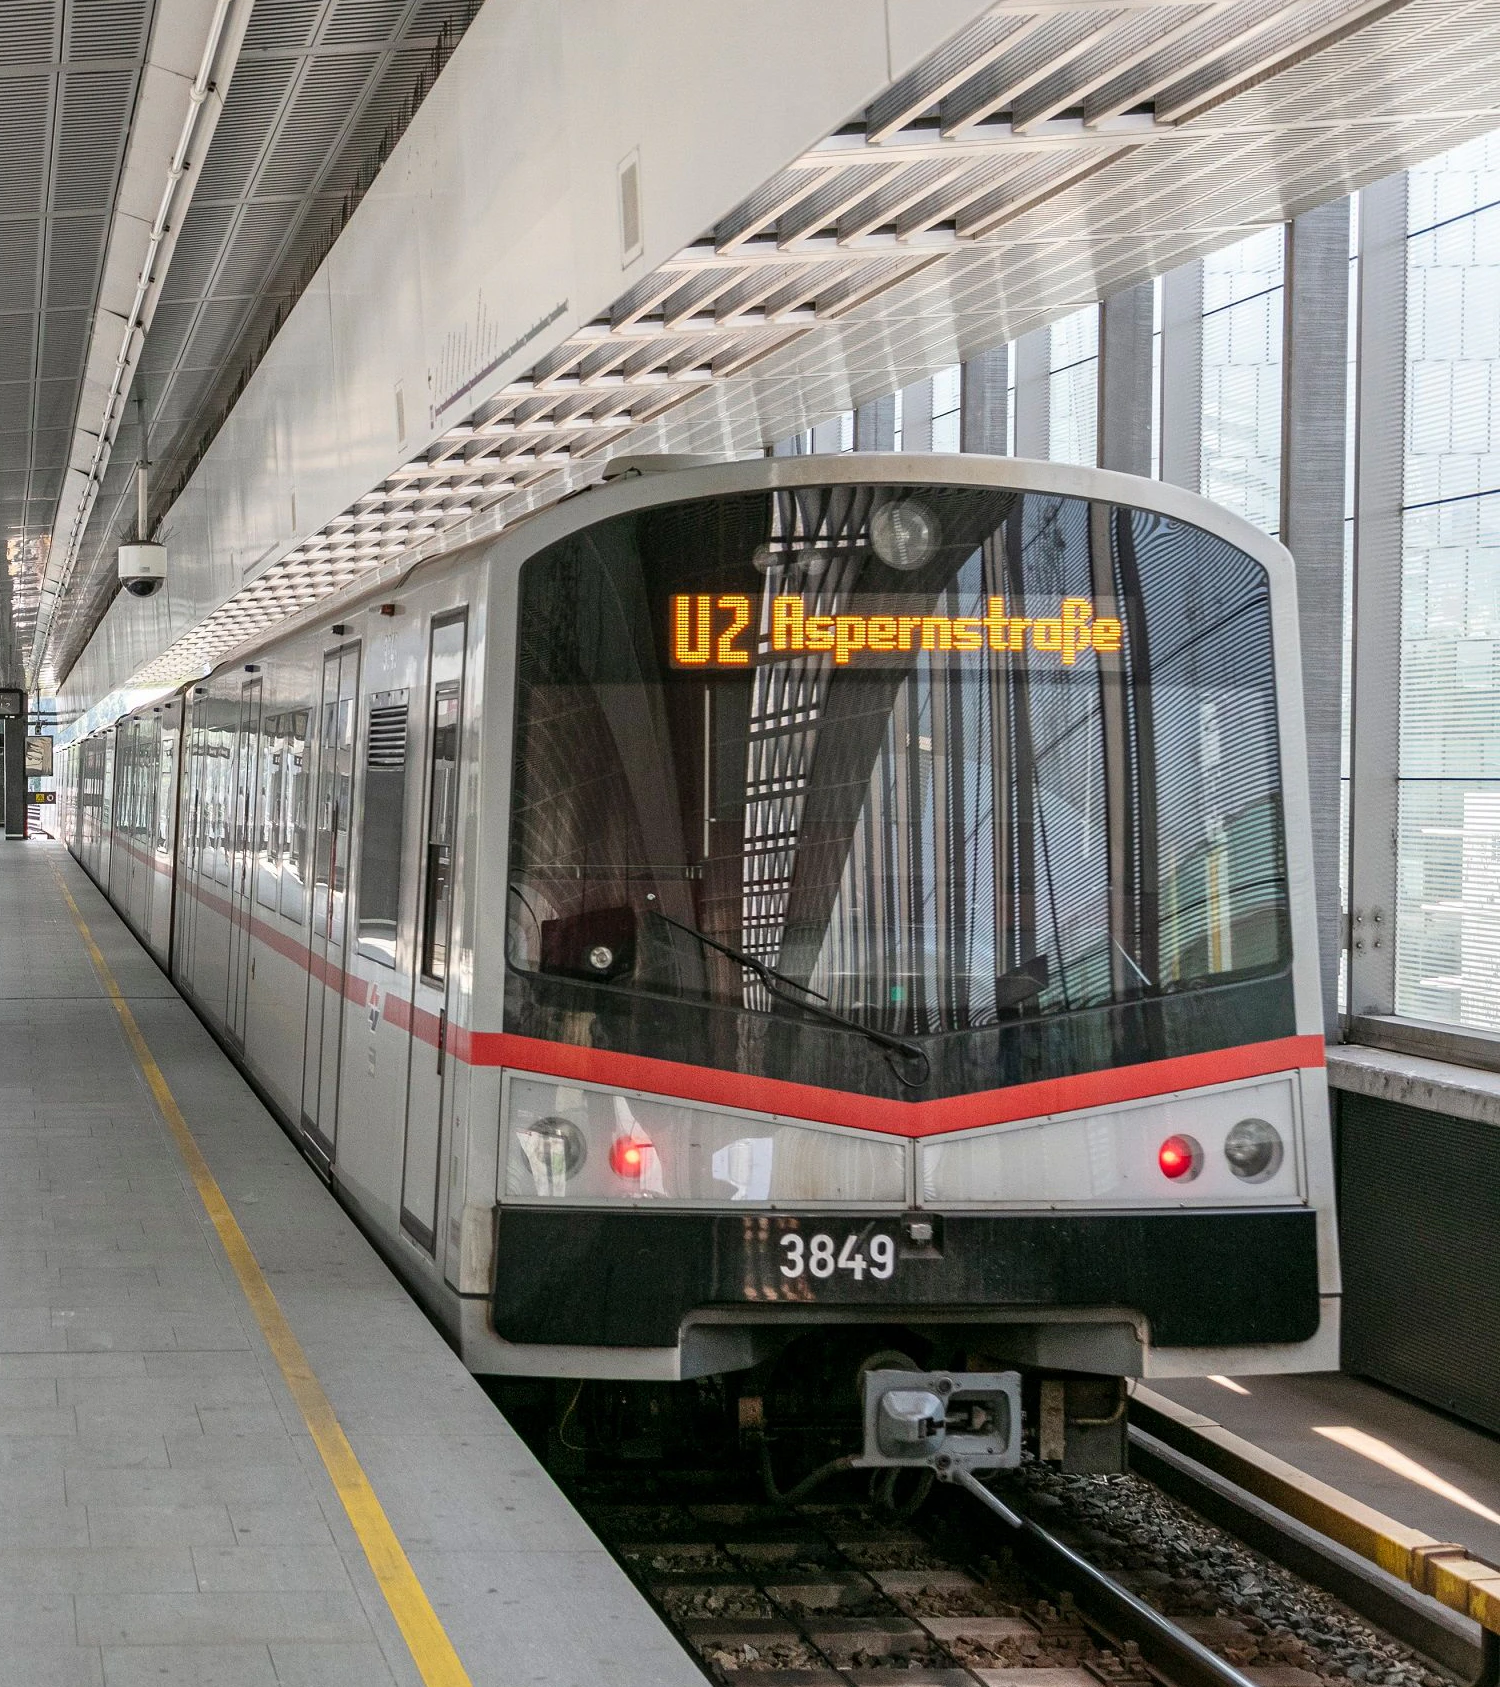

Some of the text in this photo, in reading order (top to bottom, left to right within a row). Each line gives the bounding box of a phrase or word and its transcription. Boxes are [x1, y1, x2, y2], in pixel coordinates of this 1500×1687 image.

[675, 595, 1123, 665] U2 Aspernstraße
[779, 1233, 895, 1280] 3849
